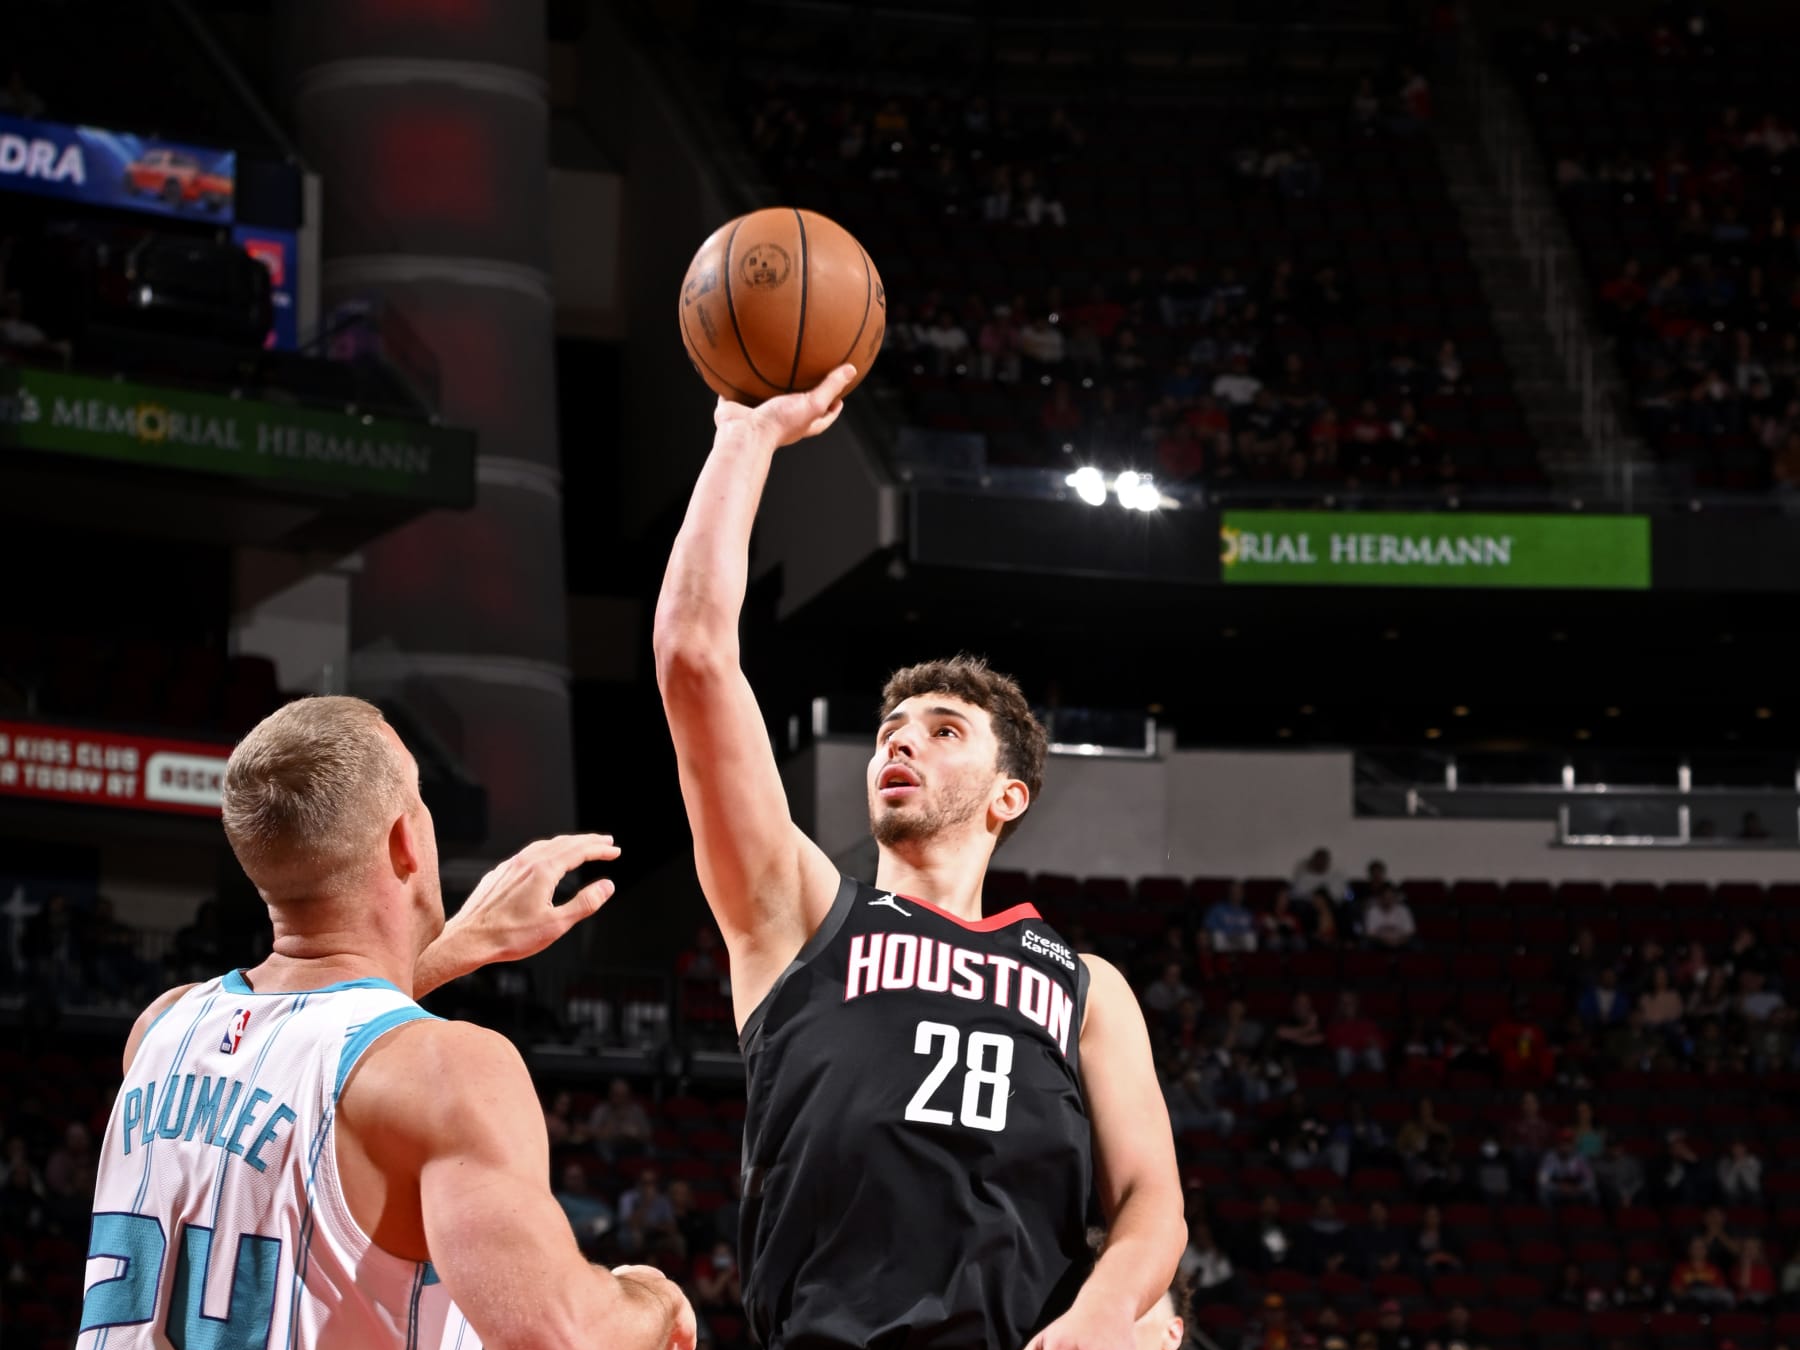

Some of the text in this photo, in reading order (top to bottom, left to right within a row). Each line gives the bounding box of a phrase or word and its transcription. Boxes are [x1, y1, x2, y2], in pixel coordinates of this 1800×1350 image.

[51, 397, 242, 450] MEMORIAL
[257, 424, 430, 473] HERMANN
[1329, 533, 1512, 565] HERMANN
[14, 737, 71, 765] KIDS
[76, 742, 138, 771] CLUB
[24, 763, 101, 793] TODAY
[107, 772, 136, 798] AT
[1022, 935, 1075, 970] karma
[1025, 930, 1071, 959] credit
[845, 931, 1073, 1057] HOUSTON
[904, 1020, 1014, 1132] 28
[123, 1074, 297, 1174] PLUMLEE
